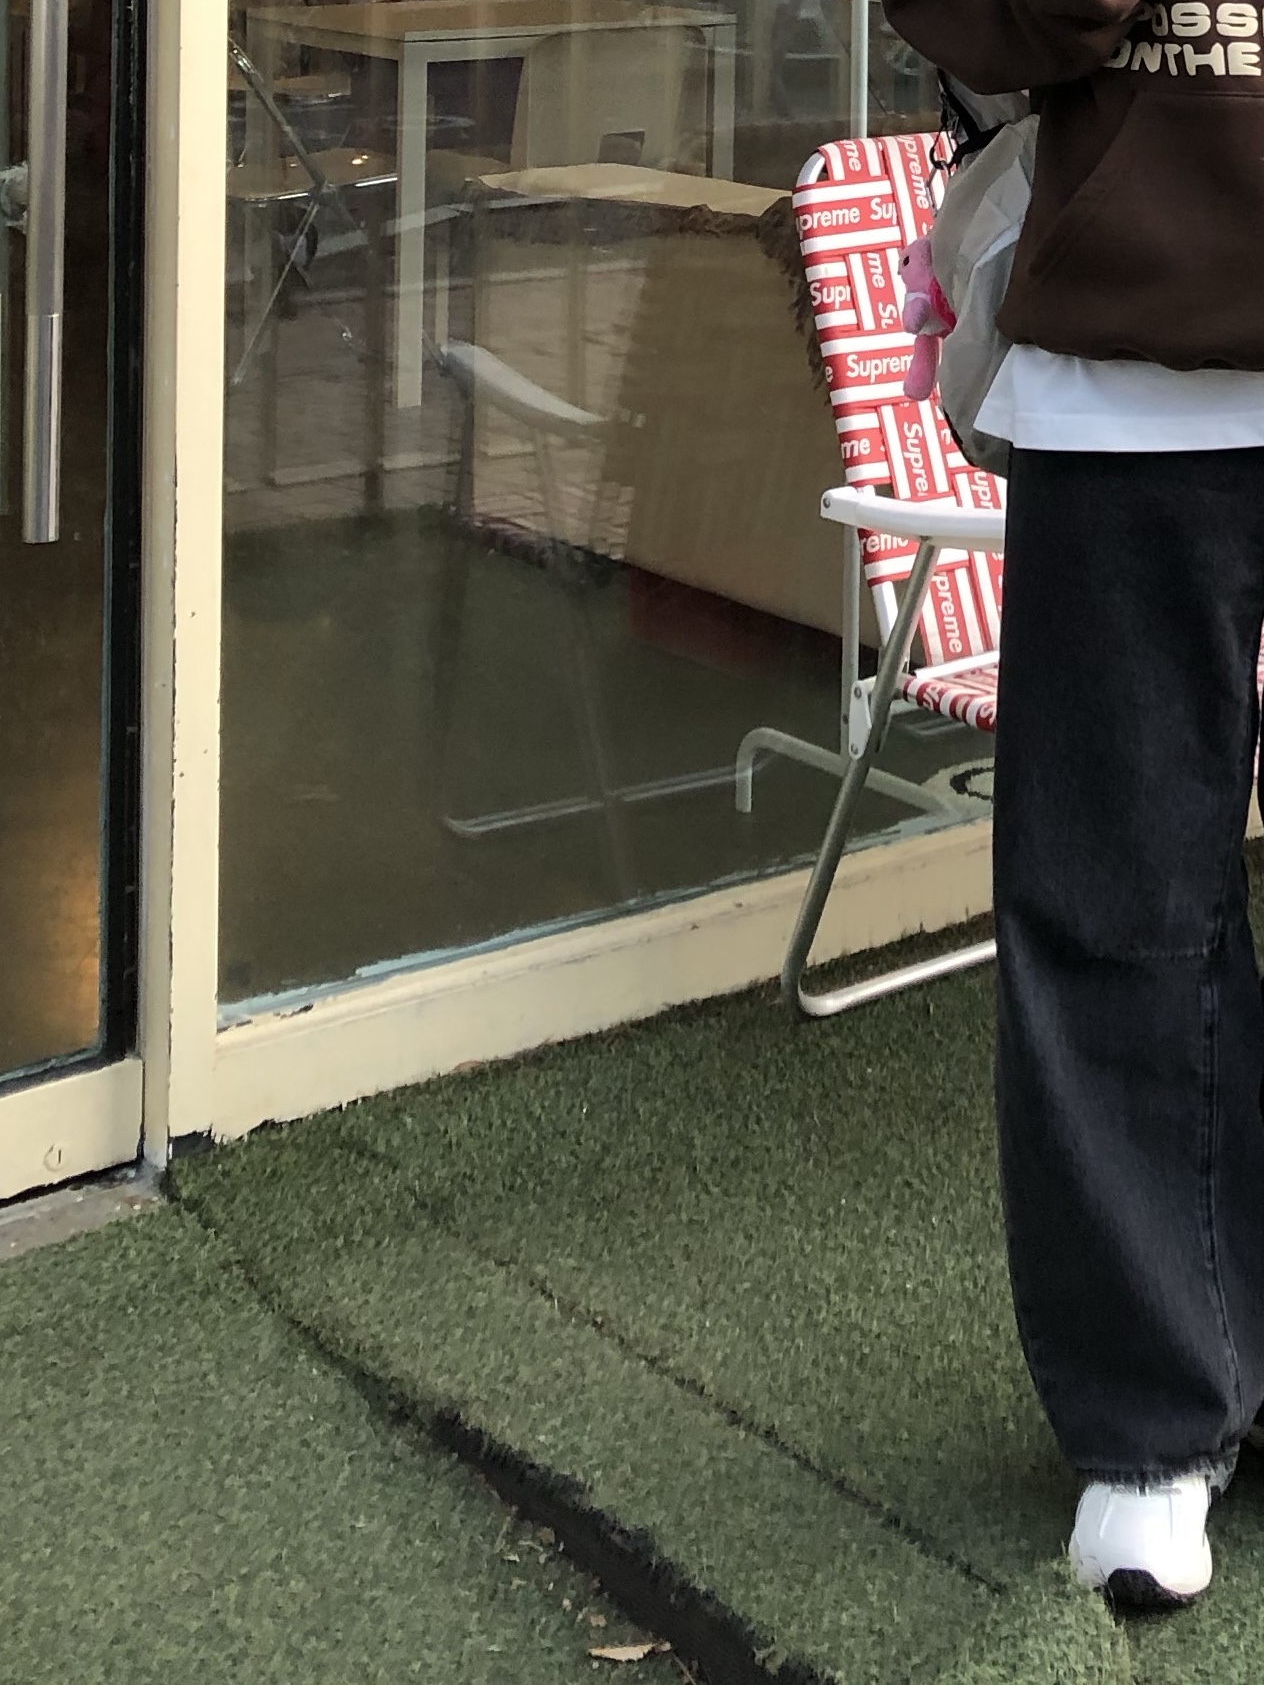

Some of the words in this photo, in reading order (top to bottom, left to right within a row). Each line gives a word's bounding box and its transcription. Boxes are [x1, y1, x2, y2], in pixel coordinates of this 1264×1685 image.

[898, 134, 930, 210] preme
[799, 205, 862, 237] preme
[810, 280, 851, 309] Supr
[847, 353, 914, 383] Suprem
[903, 421, 930, 497] Supre
[931, 571, 963, 655] preme
